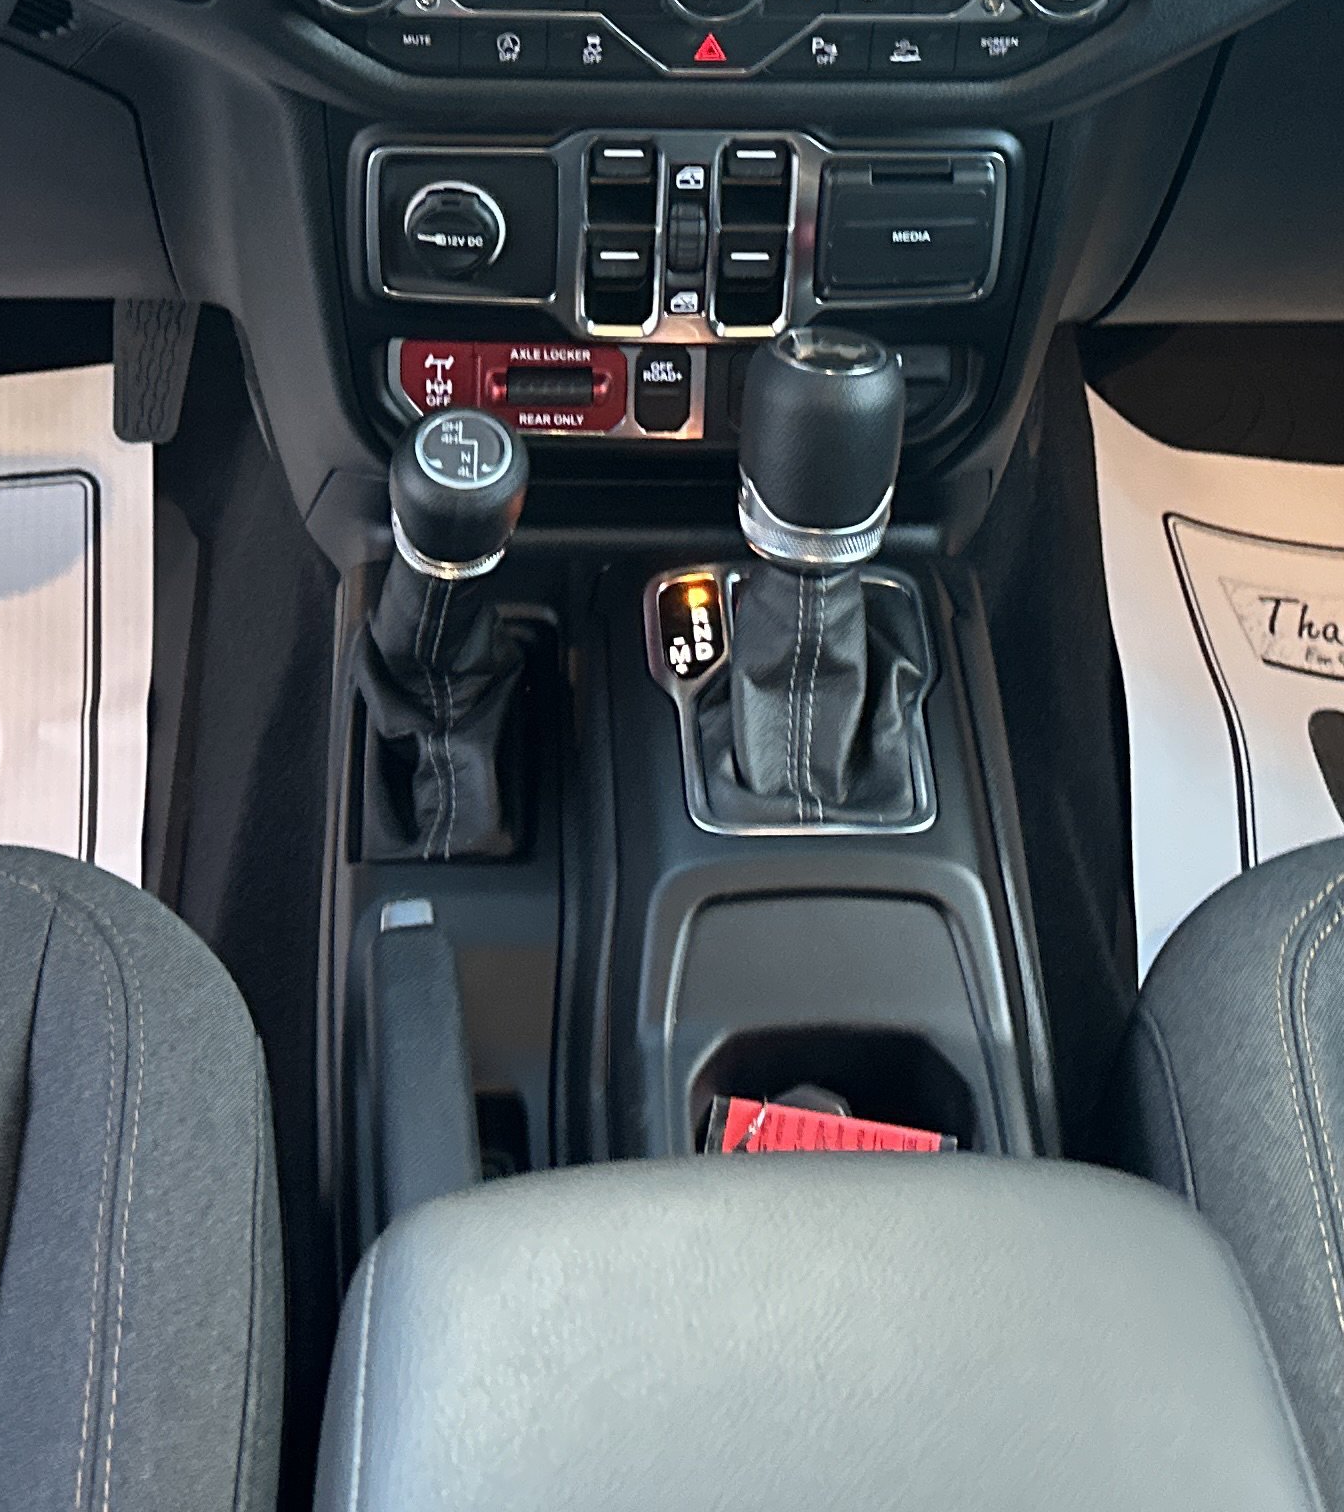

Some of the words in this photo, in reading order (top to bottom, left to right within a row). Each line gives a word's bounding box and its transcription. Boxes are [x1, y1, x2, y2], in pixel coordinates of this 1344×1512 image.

[402, 34, 432, 47] MUTE
[980, 36, 1019, 48] SCREEN
[445, 235, 465, 247] 12V
[892, 230, 931, 243] MEDIA
[510, 348, 542, 361] AXLE
[543, 348, 591, 362] LOCKER
[650, 361, 674, 373] OFF
[425, 395, 451, 408] OFF
[519, 413, 552, 426] REAR
[553, 413, 585, 426] ONLY
[460, 451, 472, 464] N
[692, 623, 713, 643] N
[669, 644, 692, 665] M
[694, 641, 715, 662] D
[1304, 645, 1333, 666] For
